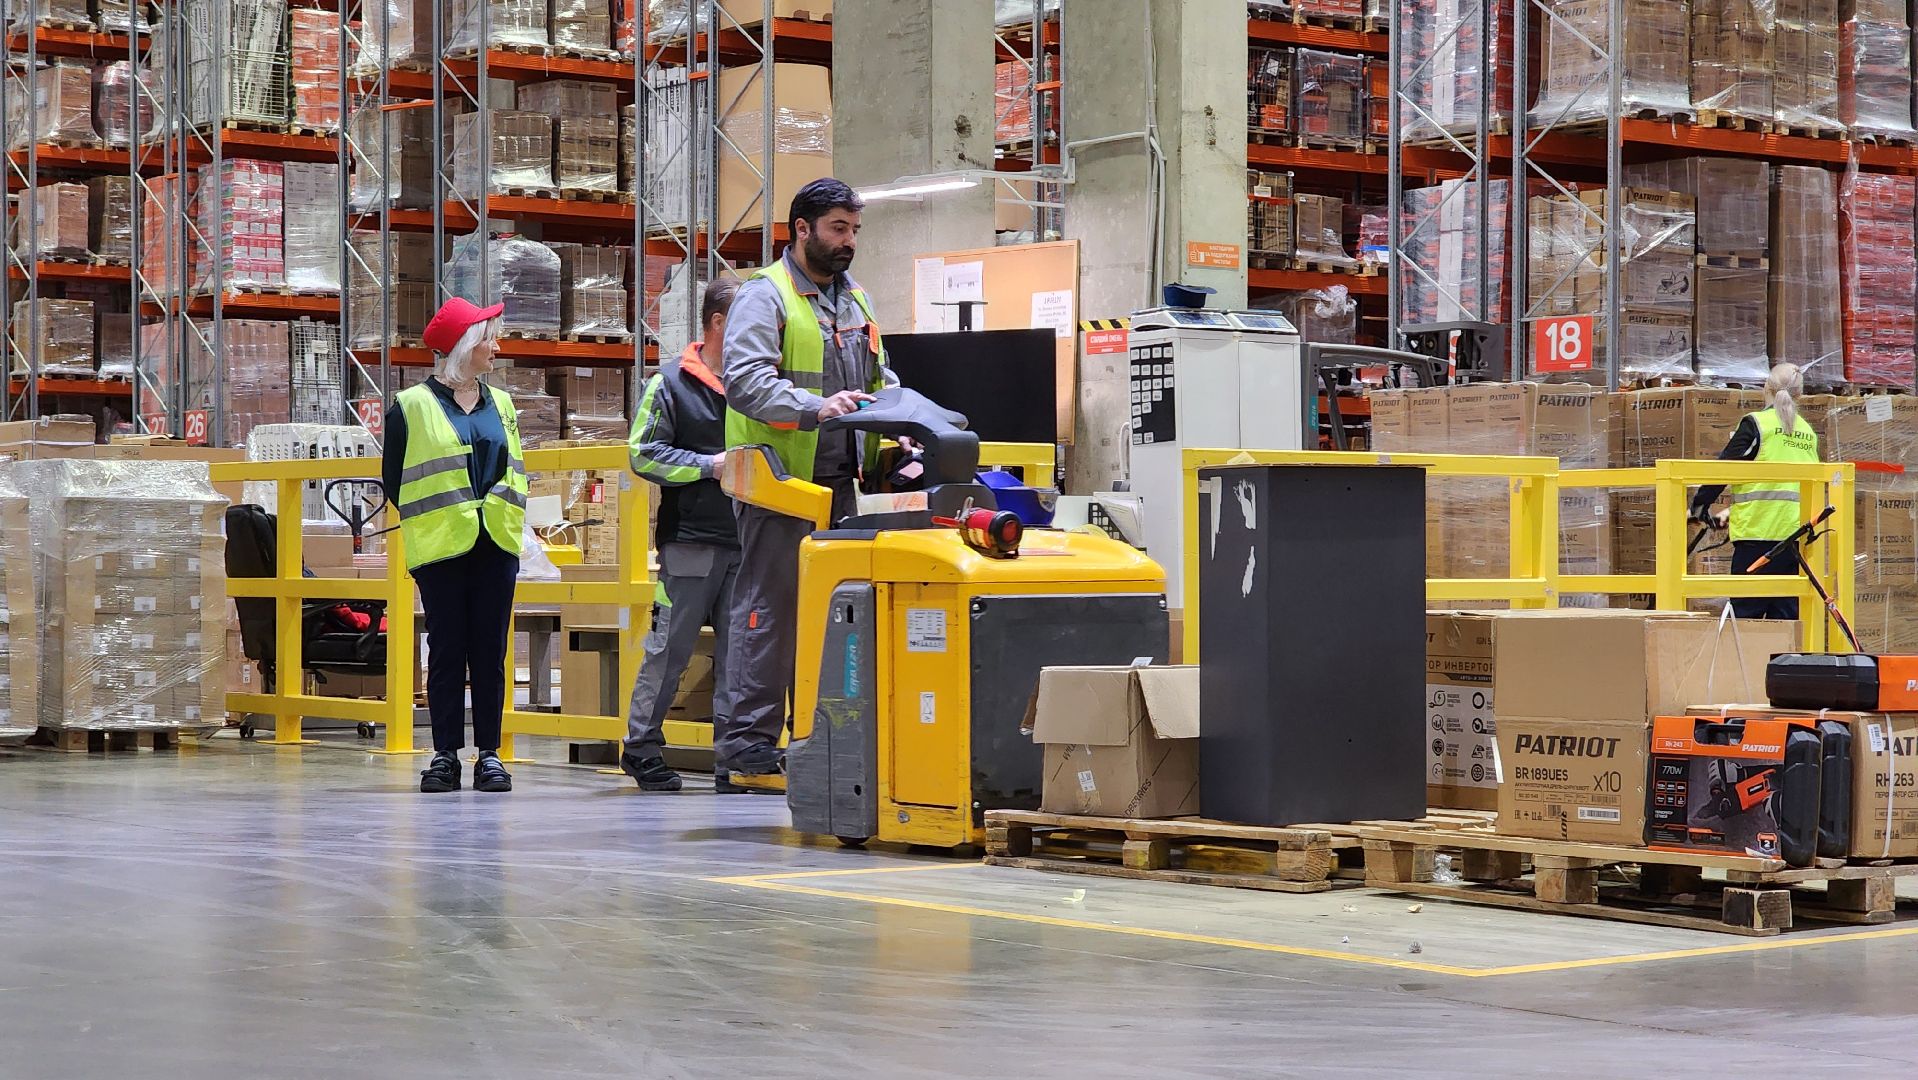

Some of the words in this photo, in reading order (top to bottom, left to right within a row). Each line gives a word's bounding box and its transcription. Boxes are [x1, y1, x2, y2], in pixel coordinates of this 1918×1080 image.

[1633, 191, 1664, 203] PATRIOT
[1545, 320, 1582, 361] 18
[1538, 394, 1596, 408] PATRIOT
[1632, 398, 1684, 411] PATRIOT
[361, 402, 382, 428] 25
[186, 414, 204, 438] 26
[1855, 592, 1887, 603] TRIOT
[1515, 733, 1621, 758] PATRIOT
[1742, 743, 1781, 753] PATRIOT
[1515, 767, 1529, 780] BR
[1530, 767, 1569, 782] 189UES
[1662, 765, 1683, 775] 770W
[1894, 773, 1915, 787] 263
[1122, 778, 1153, 817] DBERRIES
[1763, 840, 1771, 848] 2
